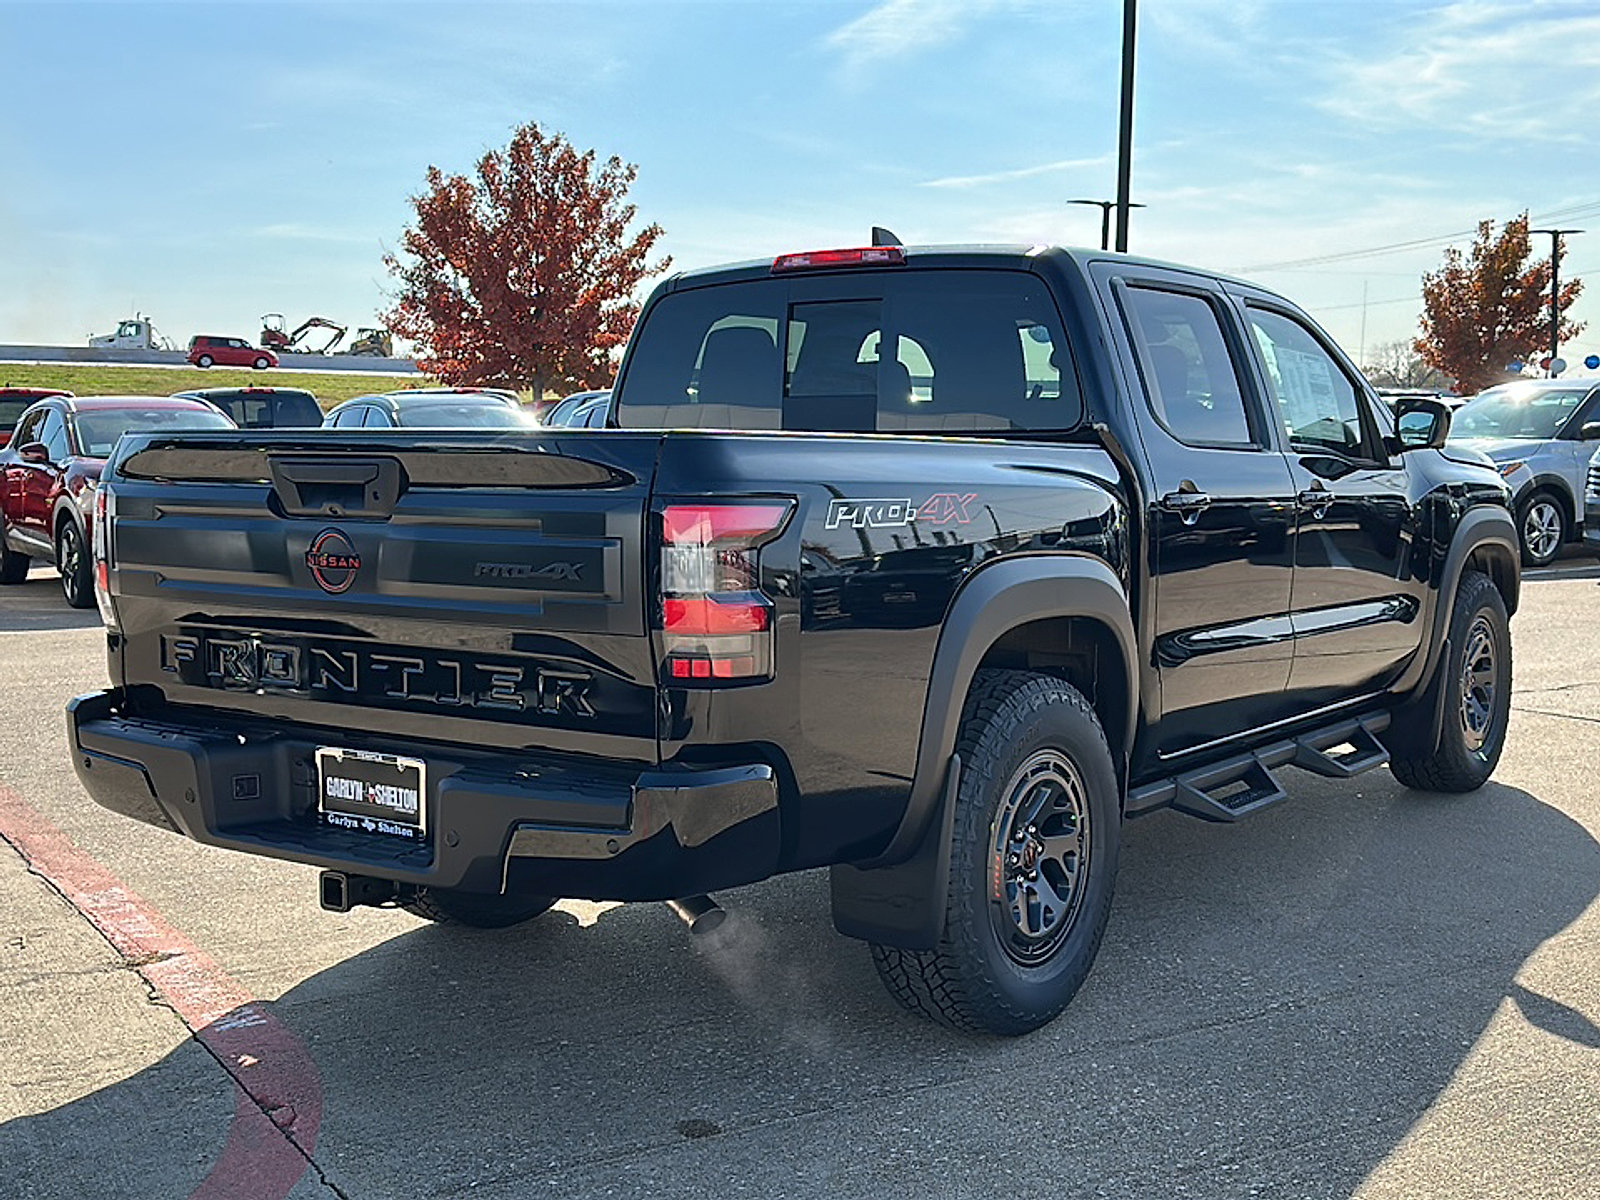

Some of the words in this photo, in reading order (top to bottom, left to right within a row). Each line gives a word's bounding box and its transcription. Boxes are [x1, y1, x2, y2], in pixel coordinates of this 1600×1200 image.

[825, 493, 978, 530] PRO-4X
[307, 554, 361, 569] NISSAN
[474, 562, 584, 581] PRO-4X
[160, 634, 597, 719] FRONTIER
[326, 776, 363, 801] GARLYN
[375, 783, 418, 811] SHELTON
[377, 821, 413, 837] Shelton
